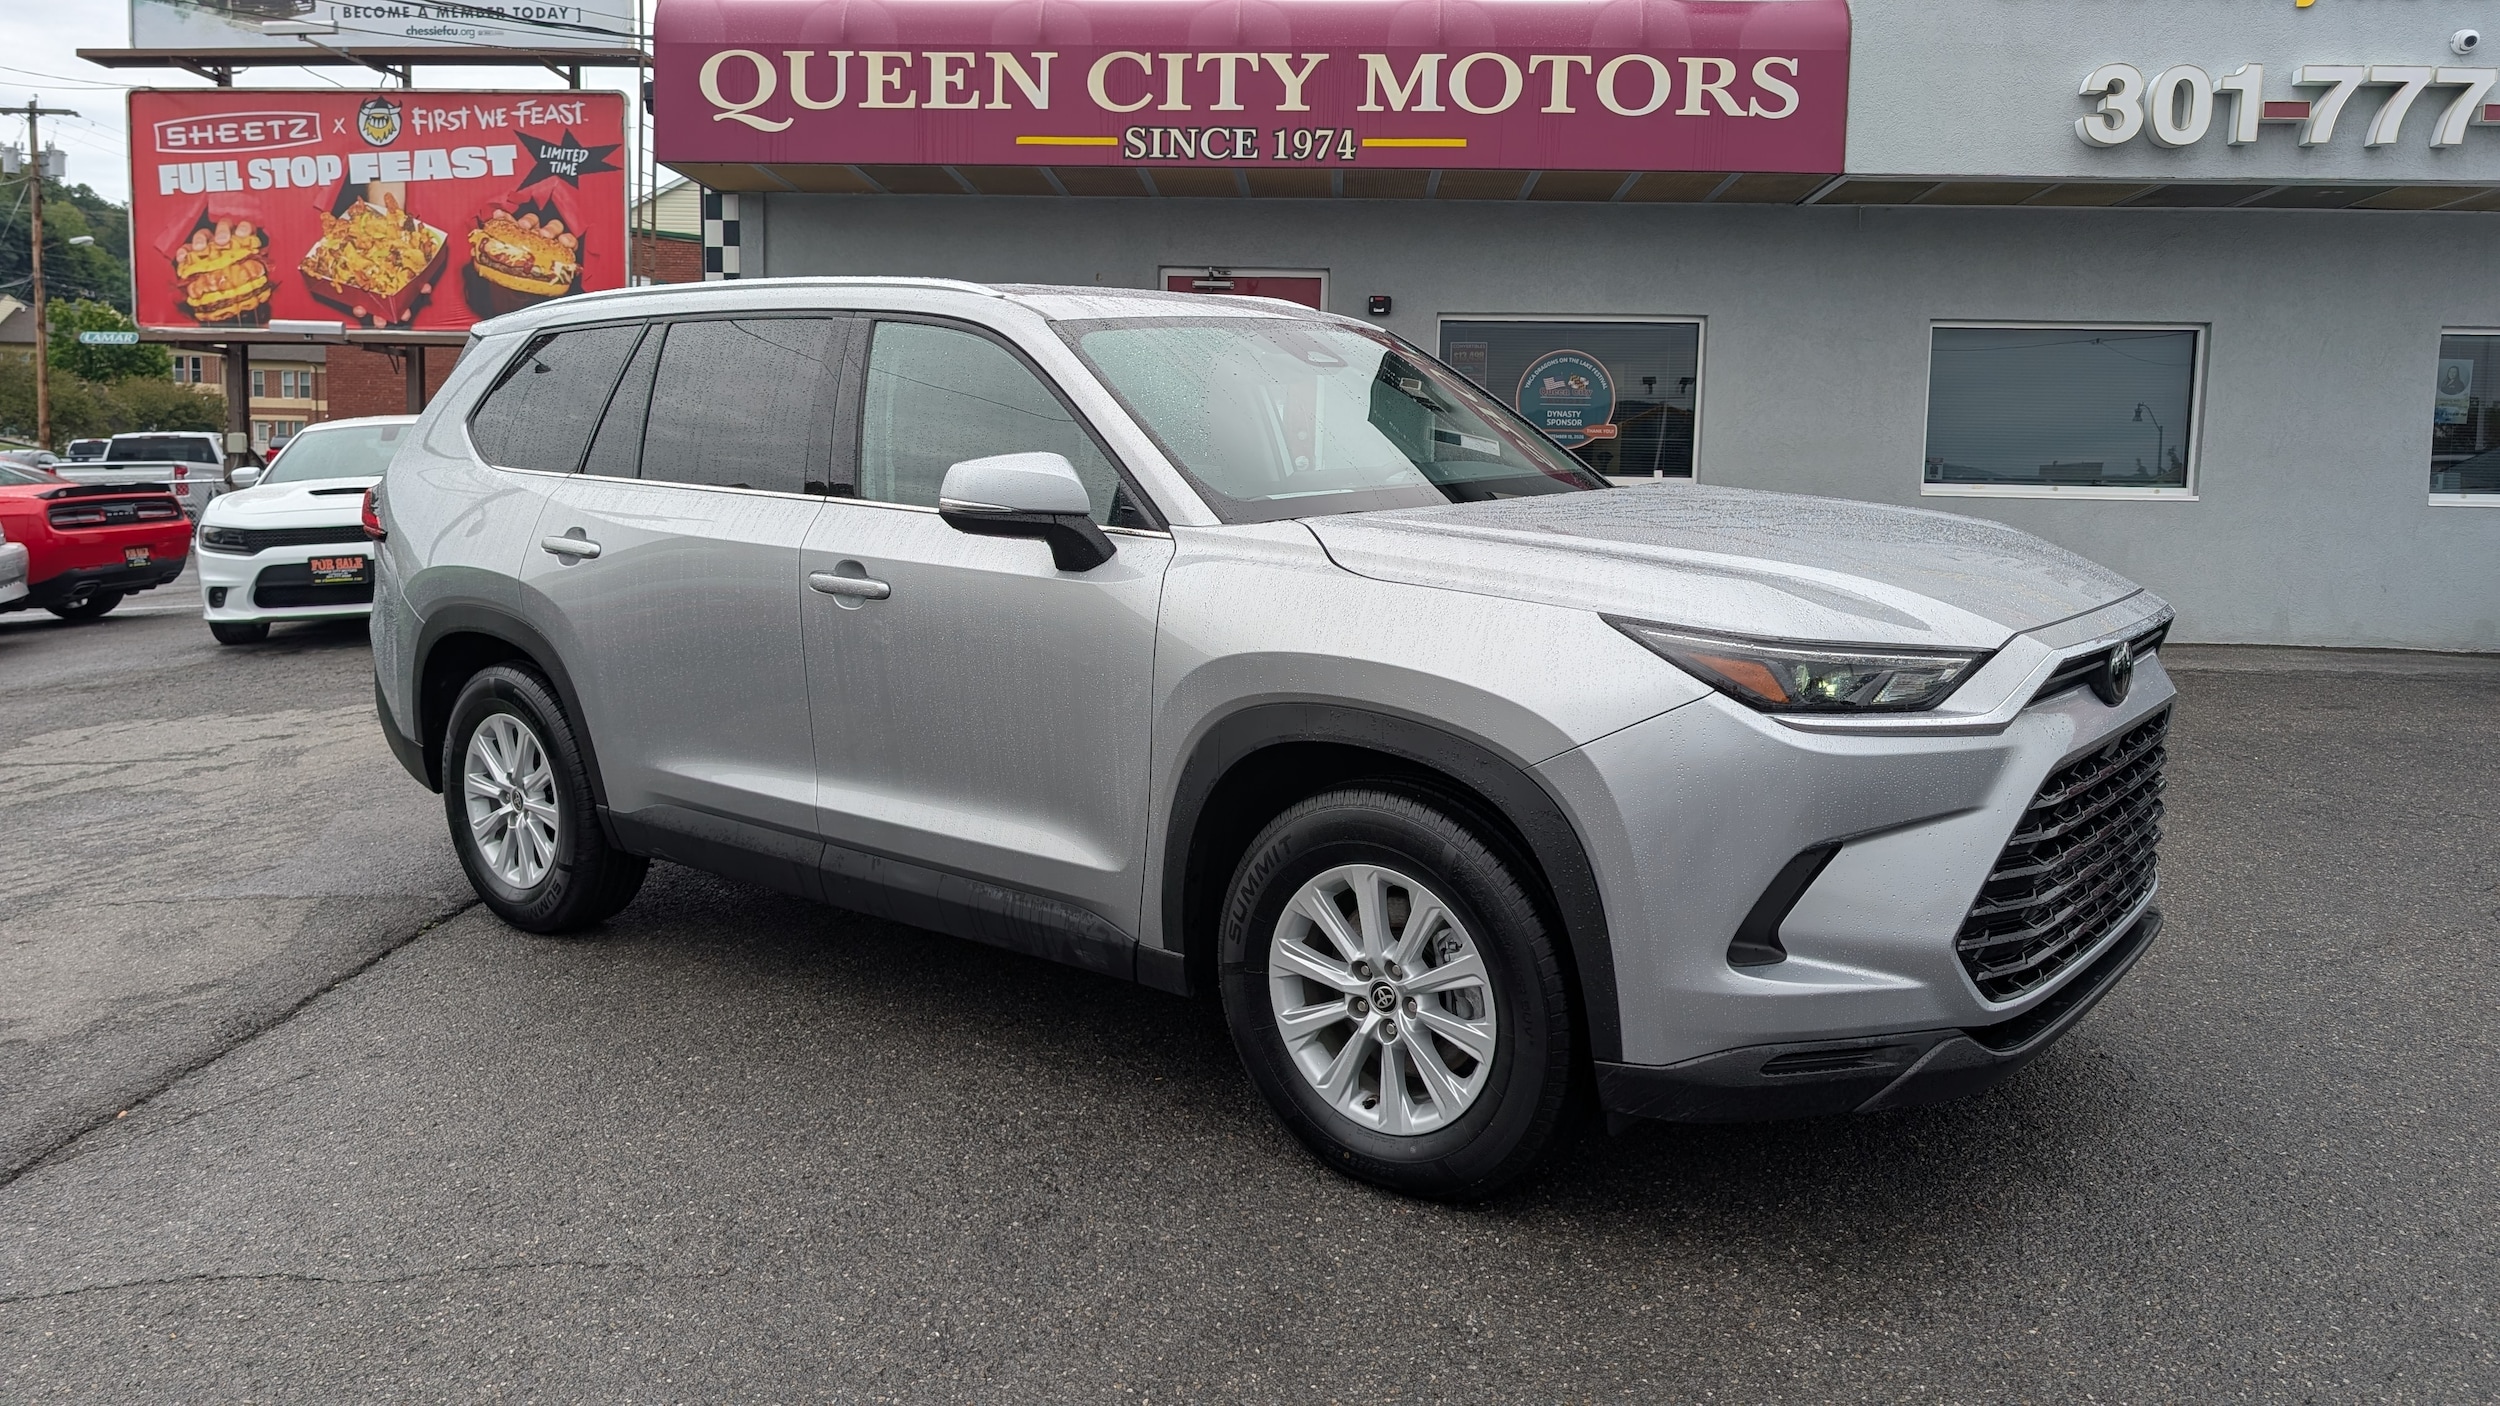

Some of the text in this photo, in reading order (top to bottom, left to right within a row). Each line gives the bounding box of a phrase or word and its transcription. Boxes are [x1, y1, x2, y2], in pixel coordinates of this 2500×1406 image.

[343, 6, 411, 19] BECOME
[418, 6, 429, 19] A
[436, 6, 506, 19] MEMBER
[513, 6, 569, 19] TODAY
[405, 25, 476, 39] chessiefcu.org
[699, 49, 1800, 133] QUEEN CITY MOTORS
[411, 99, 586, 135] FIRST WE FEAST
[166, 118, 310, 147] SHEETZ
[1123, 125, 1357, 161] SINCE 1974
[539, 145, 589, 163] LIMITED
[158, 144, 518, 196] FUEL STOP FEAST
[549, 161, 578, 177] TIME
[85, 333, 133, 342] LAMAR
[1524, 375, 1536, 389] YMCA
[1534, 359, 1559, 376] DRAGONS
[1579, 360, 1593, 370] LAKE
[1591, 367, 1608, 390] FESTIVAL
[1546, 410, 1582, 418] DYNASTY
[311, 556, 364, 571] FOR SALE
[1228, 834, 1292, 945] SUMMIT
